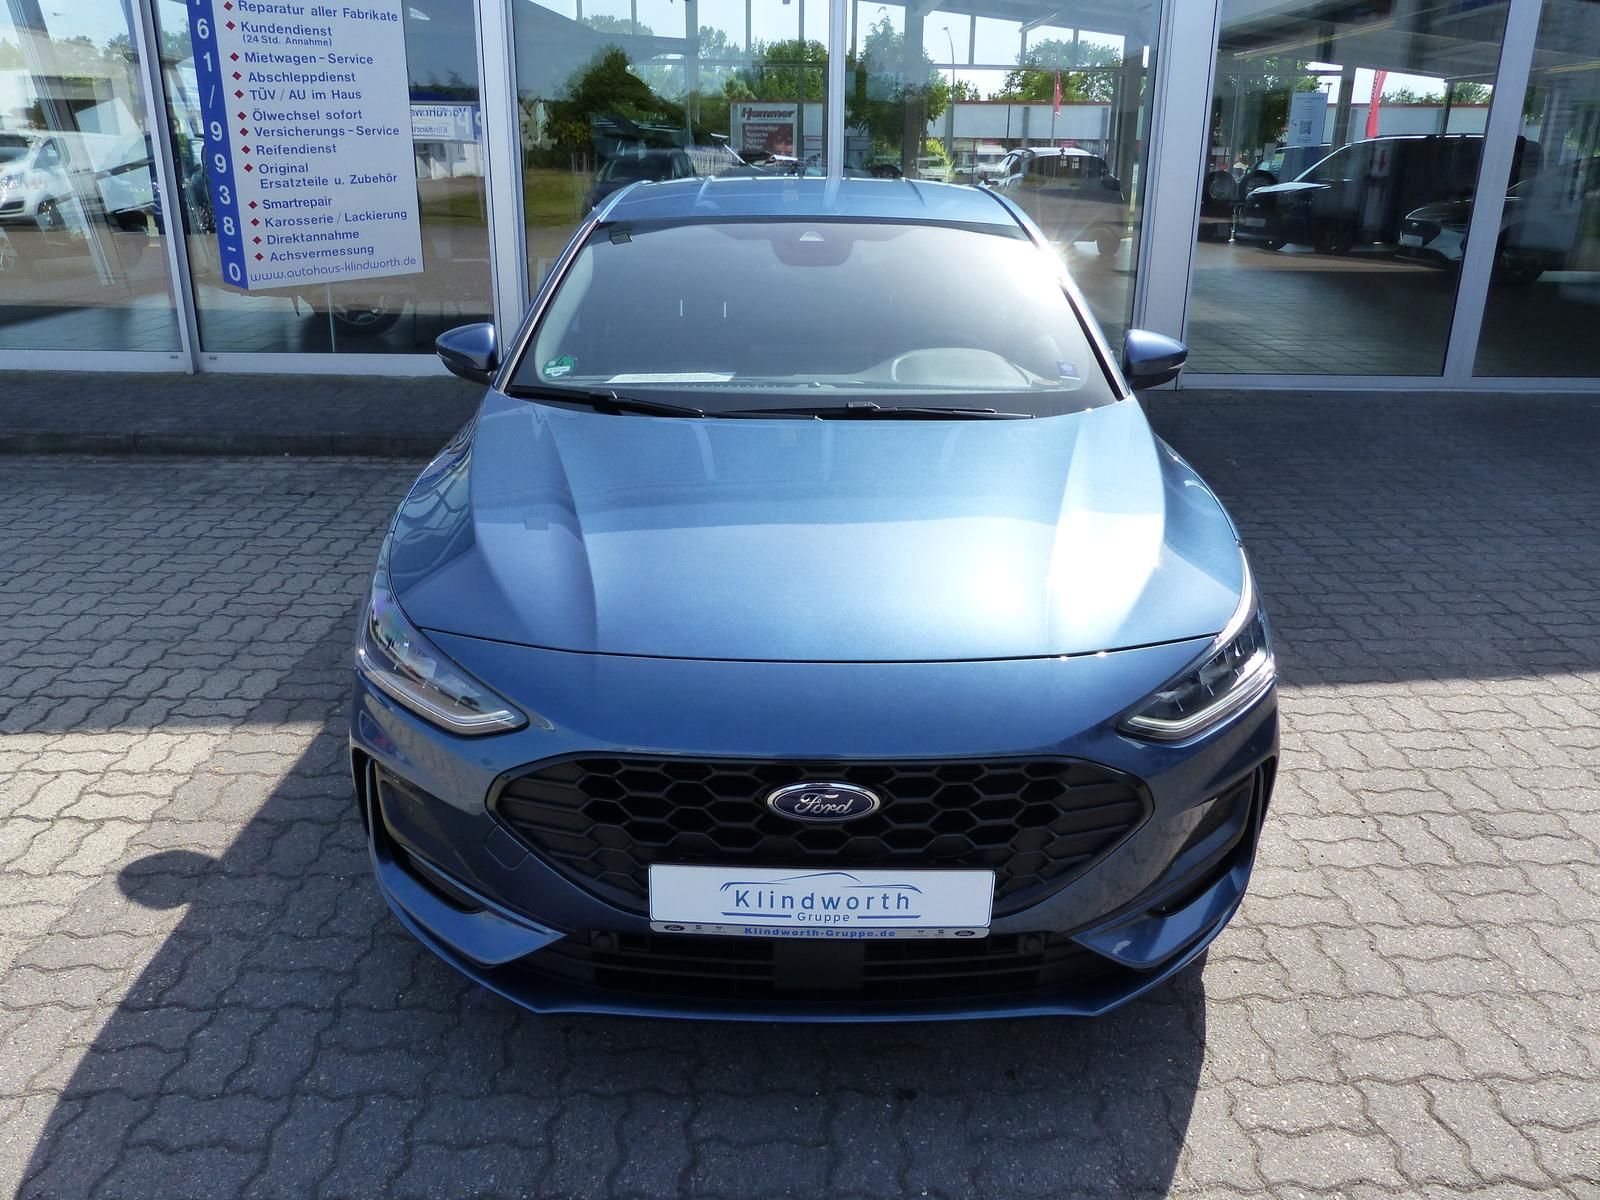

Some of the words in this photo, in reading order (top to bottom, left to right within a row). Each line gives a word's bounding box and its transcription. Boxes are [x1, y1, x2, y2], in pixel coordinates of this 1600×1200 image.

[238, 0, 305, 16] Reparatur
[311, 7, 337, 18] aller
[343, 8, 398, 22] Fabrikate
[241, 21, 333, 37] Kundendienst
[242, 34, 260, 44] (24
[261, 35, 281, 45] Std.
[285, 37, 333, 47] Annahme)
[248, 71, 356, 84] Abschleppdienst
[250, 87, 276, 101] TÜV
[288, 89, 306, 100] AU
[312, 90, 326, 100] im
[331, 88, 362, 100] Haus
[252, 108, 320, 122] Ölwechsel
[326, 109, 363, 121] sofort
[742, 107, 795, 121] Hammer
[256, 143, 337, 156] Reifendienst
[259, 163, 309, 176] Original
[260, 177, 329, 190] Ersatzteile
[335, 177, 345, 186] u.
[350, 173, 398, 185] Zubehör
[263, 196, 333, 211] Smartrepair
[267, 230, 360, 245] Direktannahme
[270, 245, 374, 263] Achsvermessung
[250, 256, 417, 283] www.autohaus-klindworth.de
[794, 793, 855, 814] Ford
[735, 889, 911, 911] Klindworth
[797, 911, 850, 924] Gruppe
[744, 927, 896, 939] Klindworth-Gruppe.de
